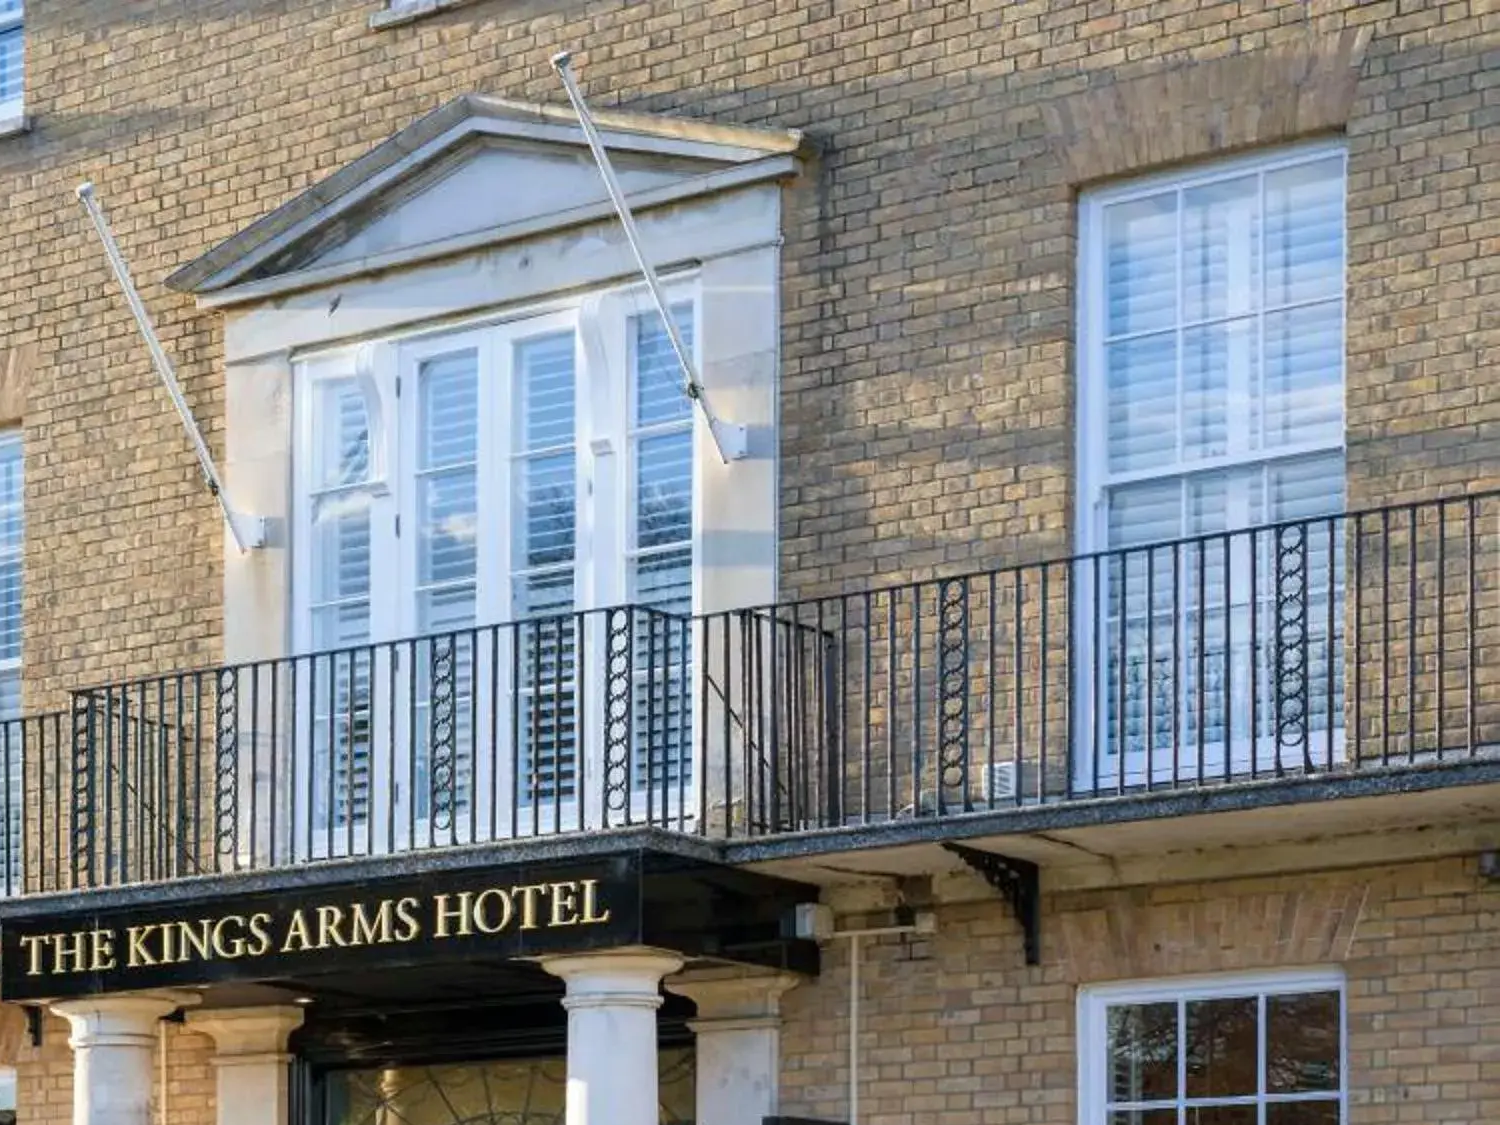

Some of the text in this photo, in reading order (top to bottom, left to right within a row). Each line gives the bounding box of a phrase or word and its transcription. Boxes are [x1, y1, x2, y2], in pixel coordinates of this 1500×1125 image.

[19, 878, 610, 977] THE KINGS ARMS HOTEL
